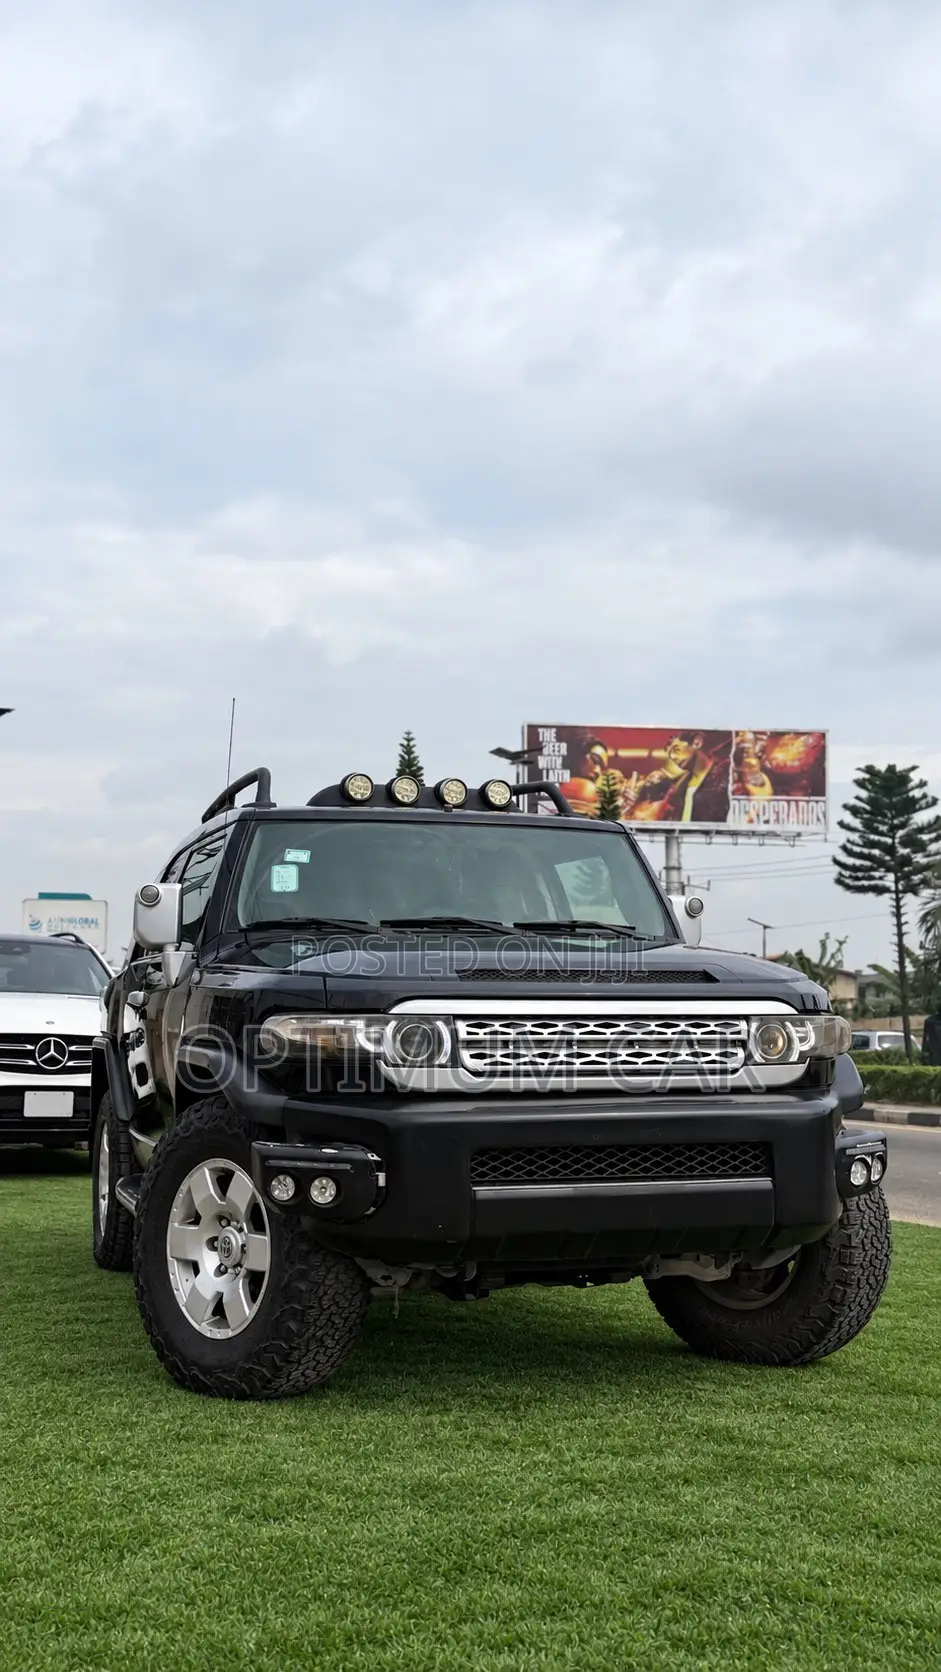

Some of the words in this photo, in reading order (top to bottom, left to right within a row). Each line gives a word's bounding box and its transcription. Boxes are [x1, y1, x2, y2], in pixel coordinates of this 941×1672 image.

[537, 728, 557, 742] THE
[542, 742, 568, 756] BEER
[731, 800, 826, 827] DESPERADOS
